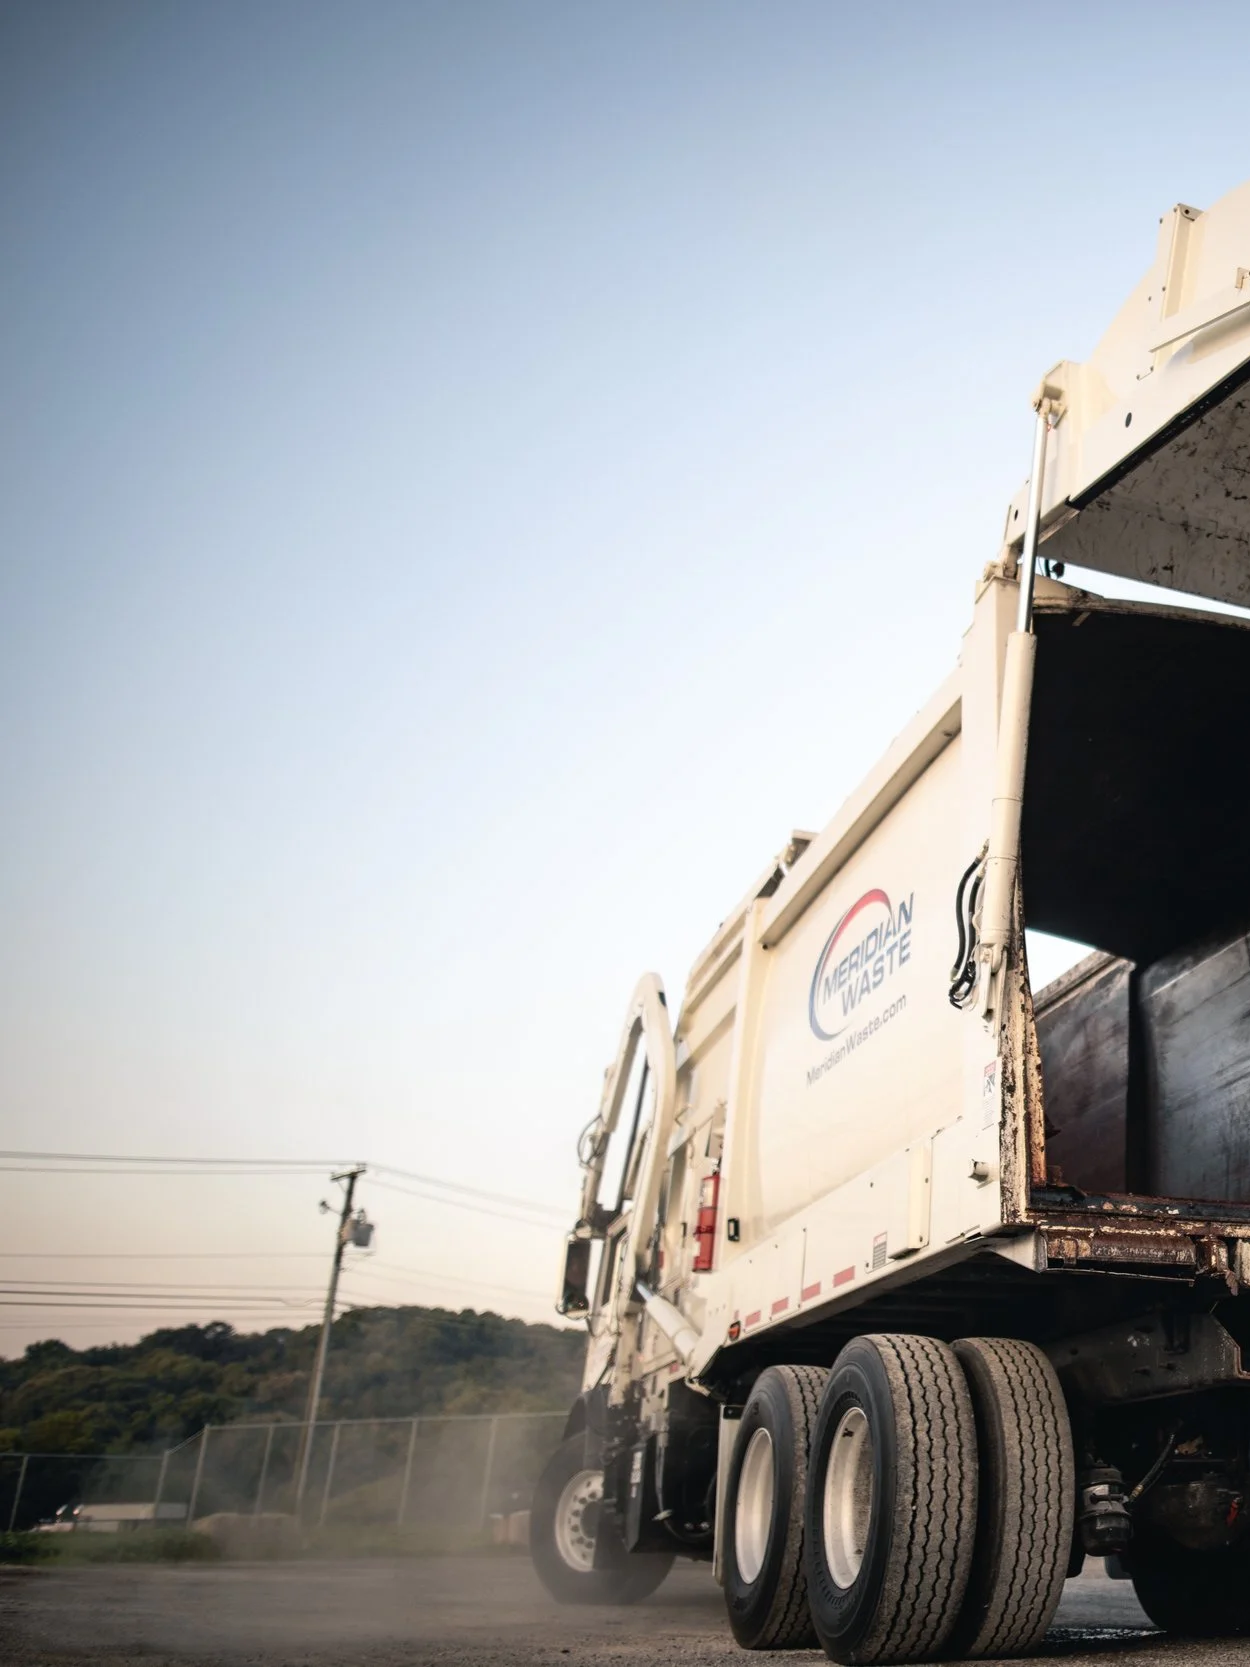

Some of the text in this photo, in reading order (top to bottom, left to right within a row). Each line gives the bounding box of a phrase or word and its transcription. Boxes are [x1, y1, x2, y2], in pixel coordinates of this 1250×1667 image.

[822, 891, 915, 1005] MERIDIAN
[841, 929, 912, 1017] WASTE
[806, 993, 908, 1088] MeridianWaste.com
